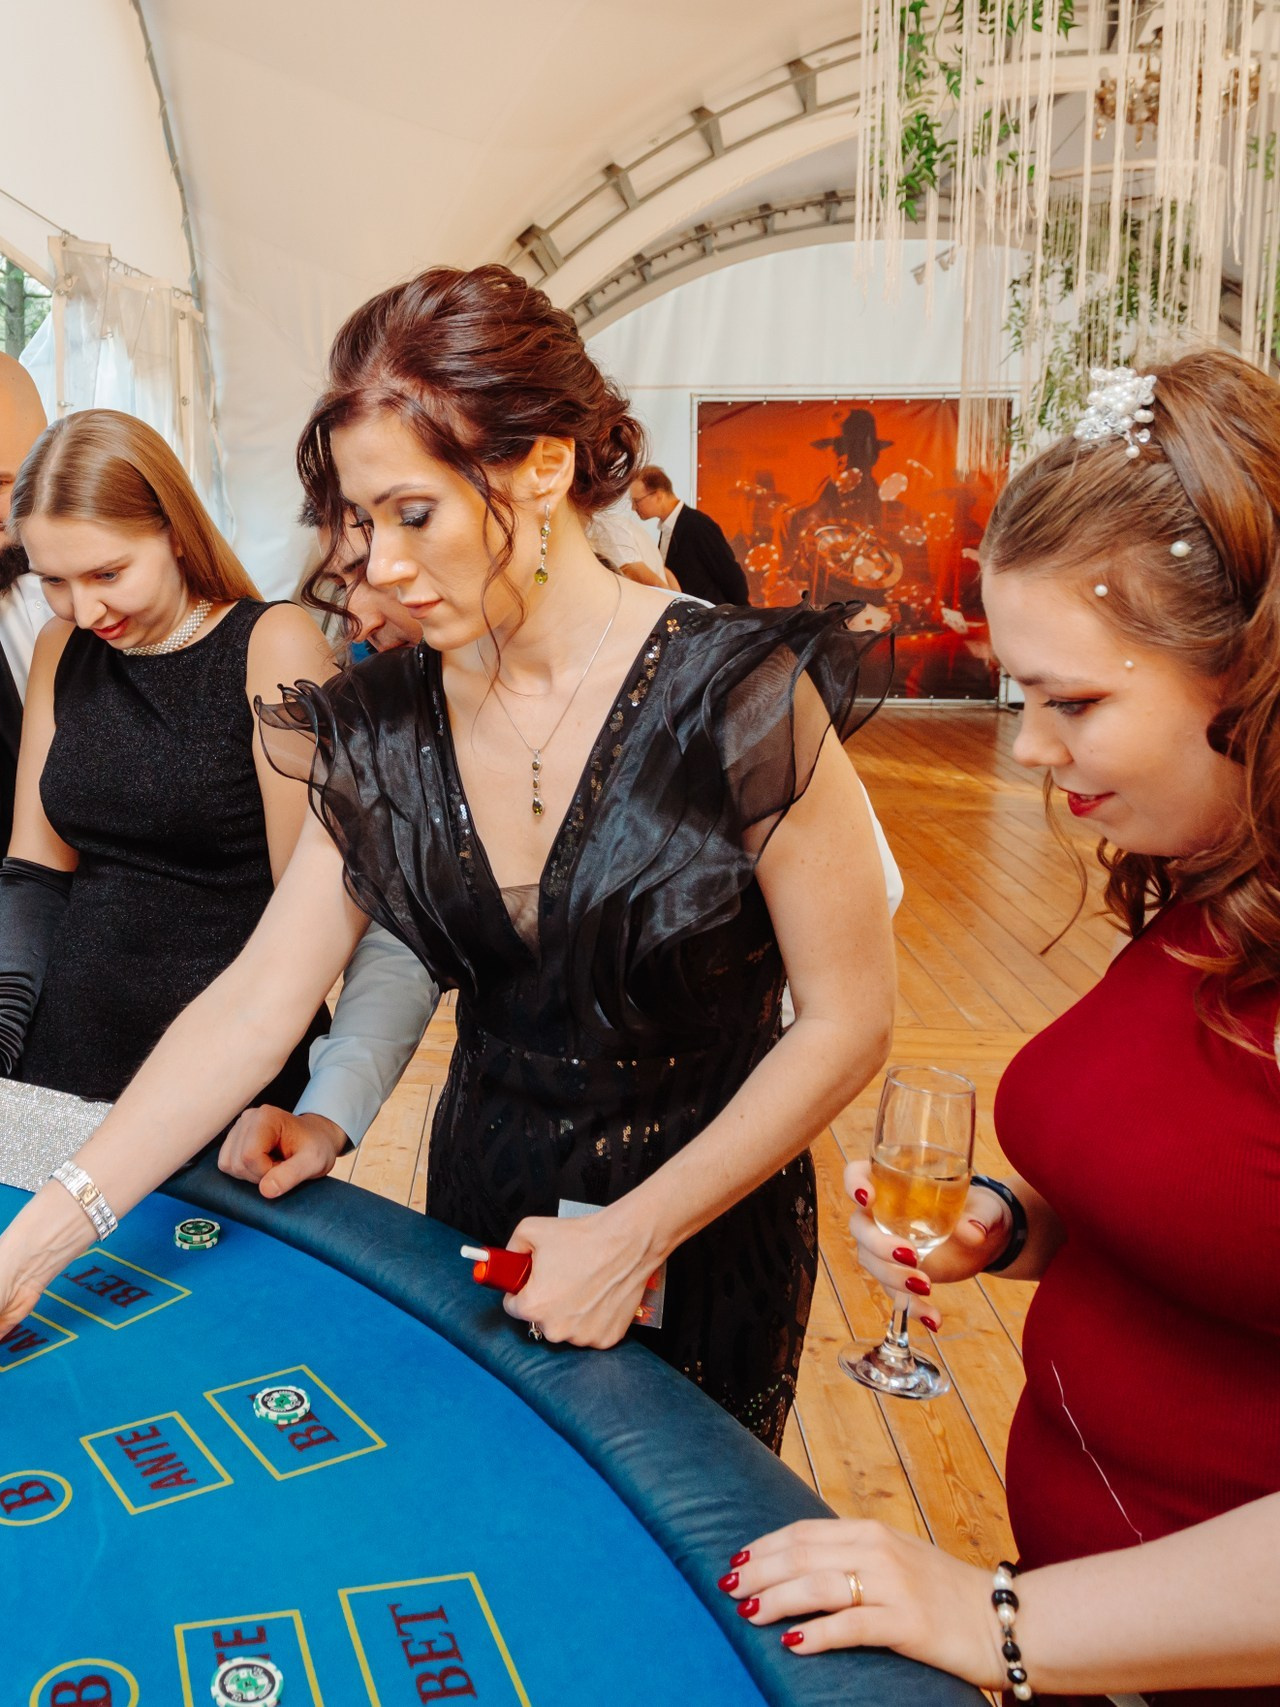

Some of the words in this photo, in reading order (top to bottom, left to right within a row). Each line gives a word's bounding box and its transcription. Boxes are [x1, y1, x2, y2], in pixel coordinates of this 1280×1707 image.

[62, 1265, 154, 1309] BET
[114, 1424, 198, 1492] ANTE
[387, 1602, 479, 1706] BET
